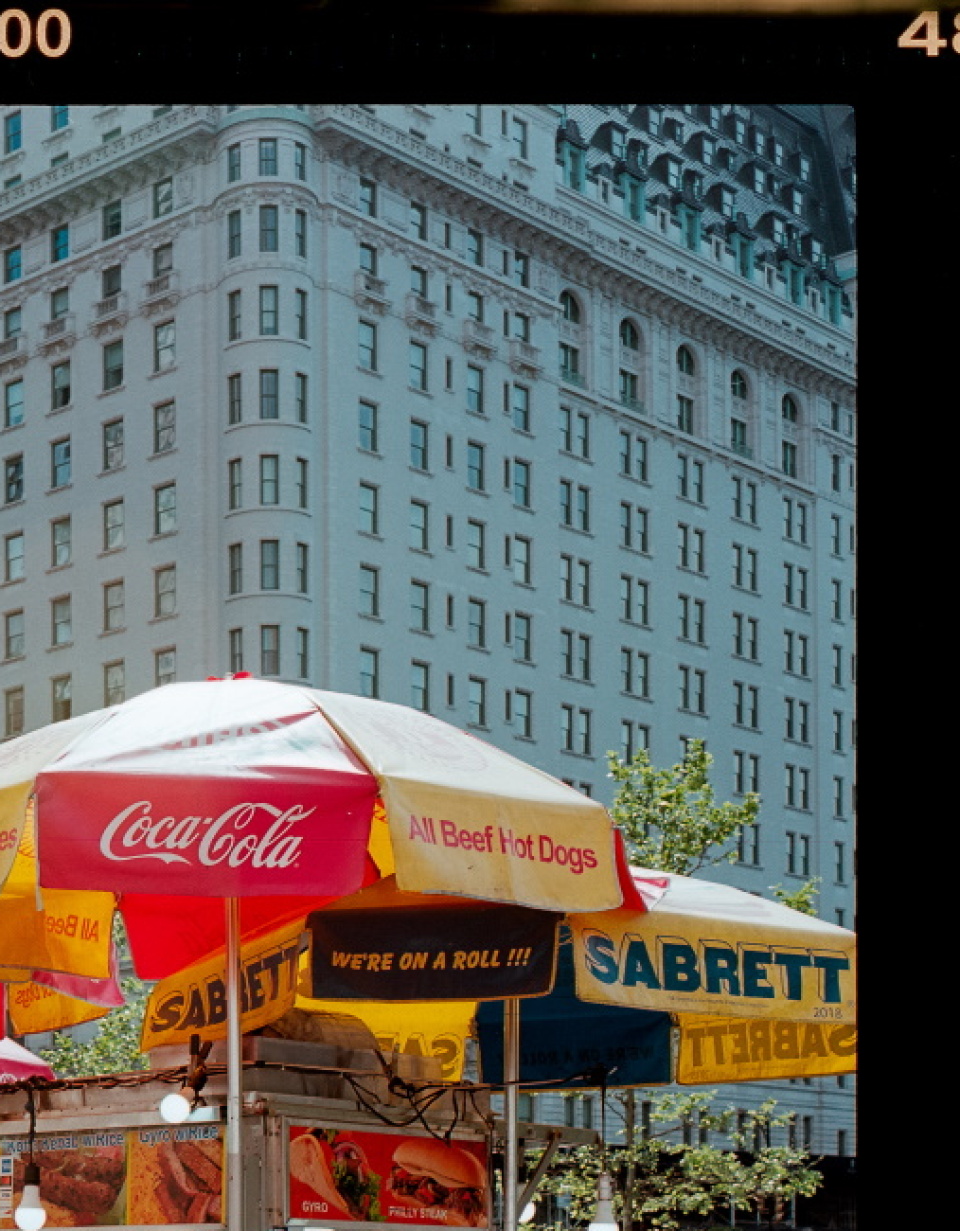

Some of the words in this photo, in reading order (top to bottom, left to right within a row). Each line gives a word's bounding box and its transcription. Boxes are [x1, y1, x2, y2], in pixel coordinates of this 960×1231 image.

[99, 800, 317, 869] Coca-Cola
[409, 814, 437, 845] All
[440, 819, 493, 853] Beef
[498, 826, 535, 861] Hot
[539, 834, 599, 875] Dogs
[331, 950, 395, 973] WE'RE
[399, 951, 429, 971] ON
[433, 951, 446, 970] A
[452, 949, 501, 971] ROLL
[506, 946, 533, 967] !!!
[582, 928, 850, 1004] SABRETT
[813, 1006, 844, 1020] 2018
[302, 1200, 329, 1213] GYRO
